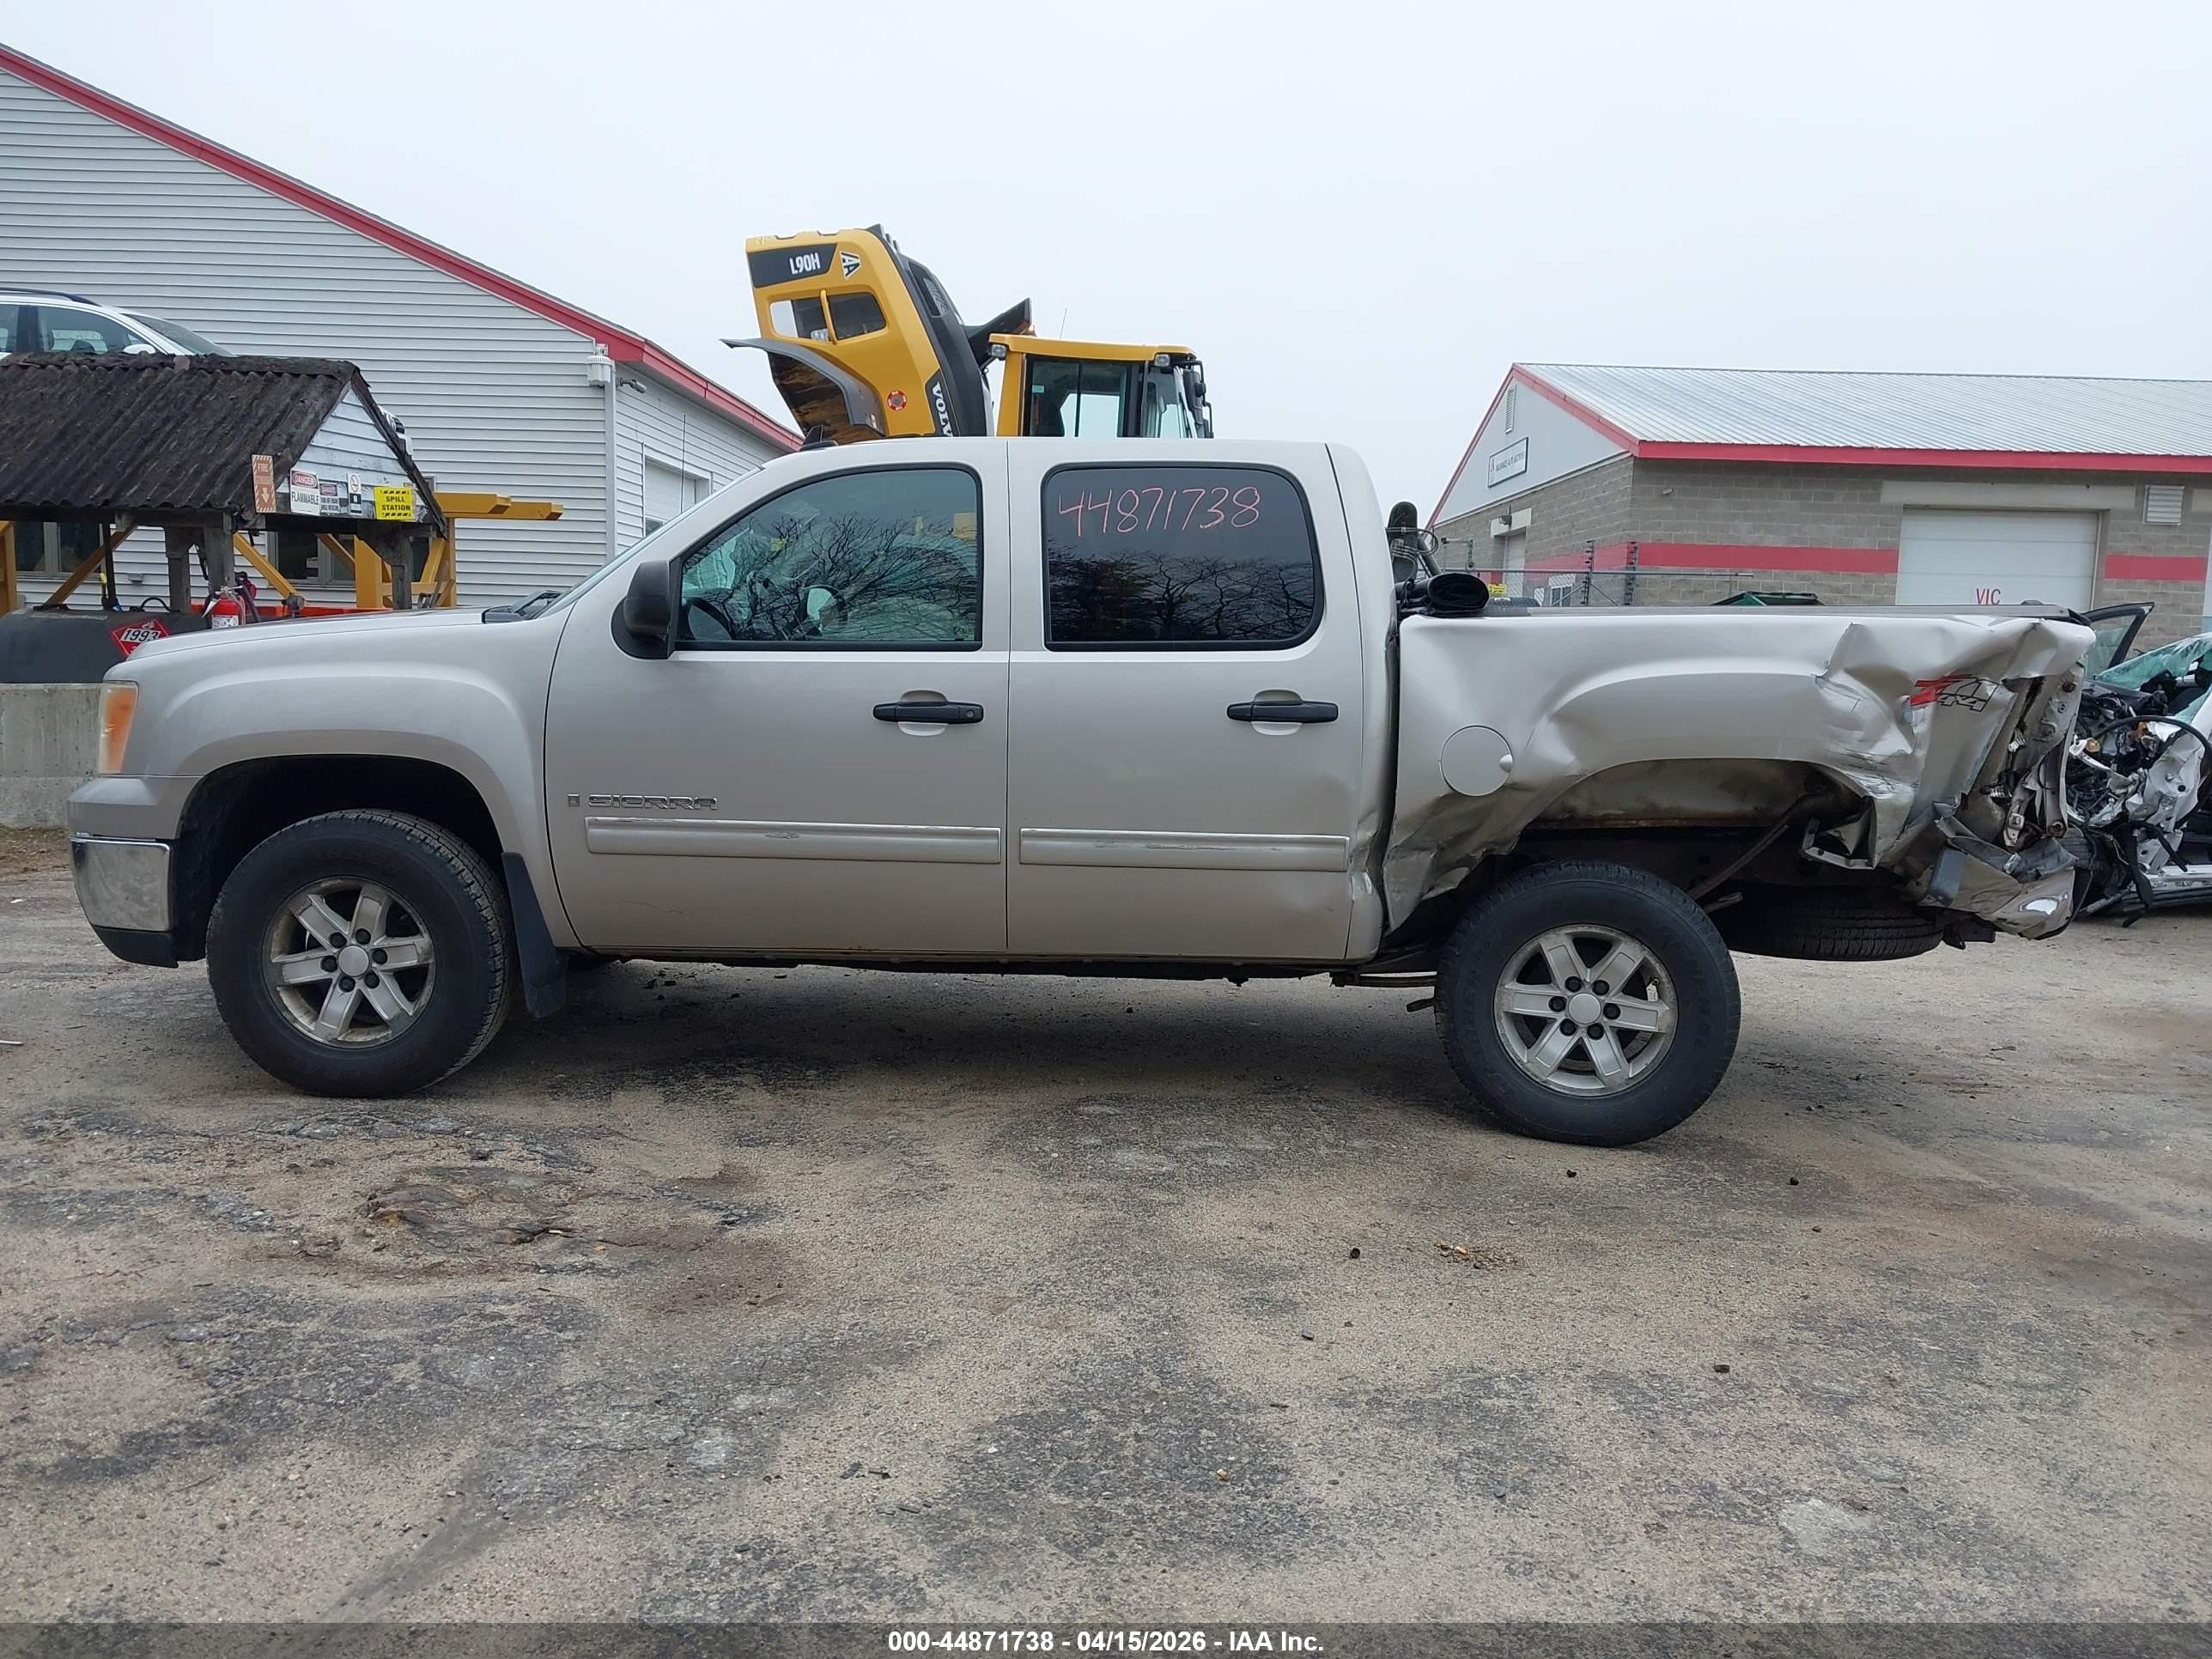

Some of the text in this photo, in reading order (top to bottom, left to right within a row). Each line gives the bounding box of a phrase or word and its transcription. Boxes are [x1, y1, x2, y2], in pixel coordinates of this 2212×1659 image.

[789, 252, 822, 275] L90H
[932, 381, 954, 437] VOLV
[294, 473, 316, 486] DANGER
[291, 491, 319, 505] FLAMMABLE
[1058, 486, 1261, 537] 44871738
[1976, 587, 2002, 605] VIC
[123, 629, 159, 642] 1993
[588, 793, 718, 811] SIERRA
